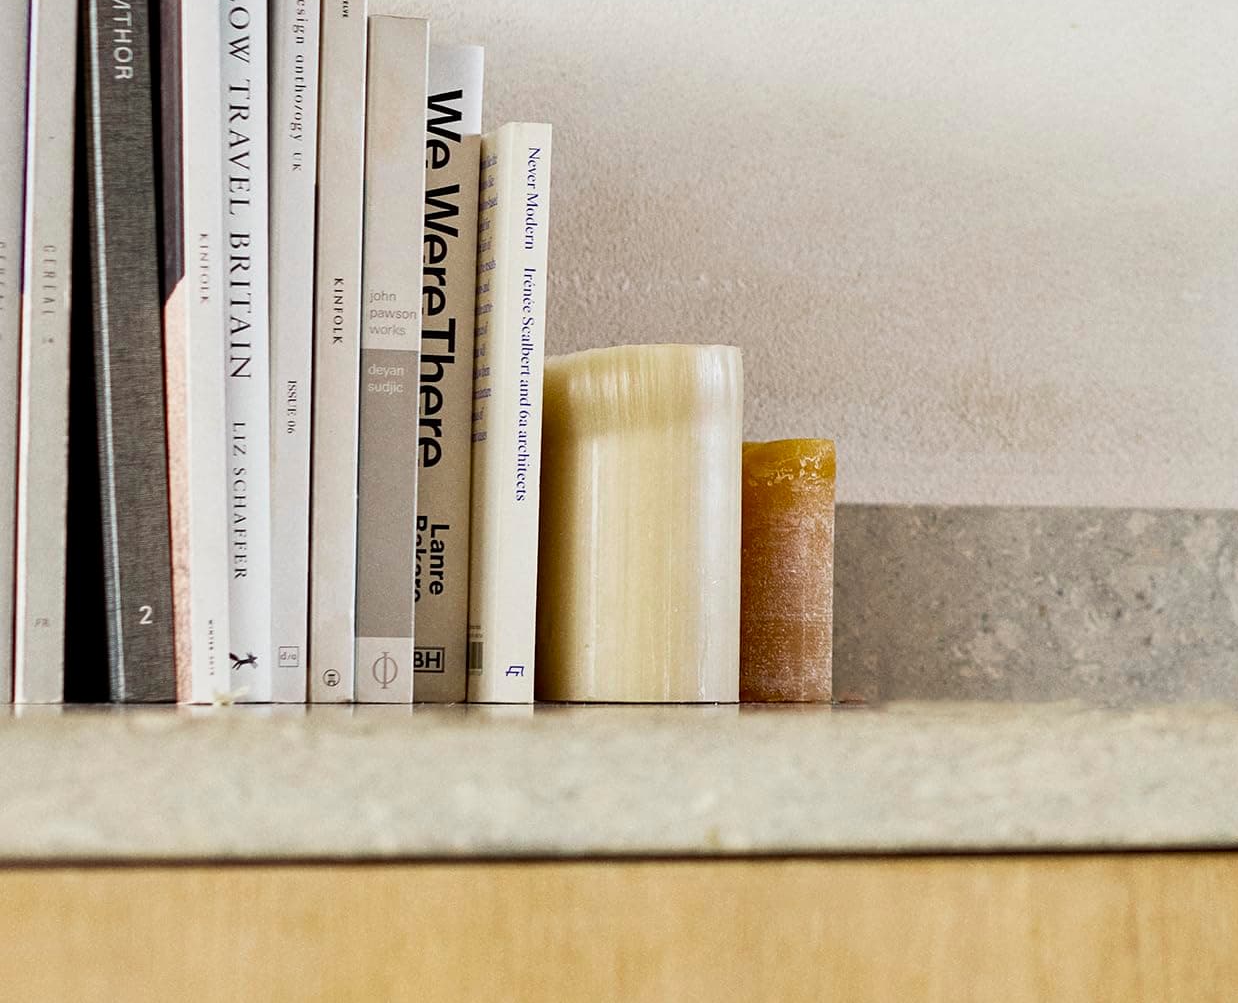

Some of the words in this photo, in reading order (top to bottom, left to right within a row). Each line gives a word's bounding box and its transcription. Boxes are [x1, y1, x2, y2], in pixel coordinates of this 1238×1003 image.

[228, 79, 251, 216] TRAVEL
[426, 90, 464, 169] We
[292, 152, 302, 171] UK
[527, 147, 541, 190] Never
[524, 193, 539, 250] Modern
[199, 233, 209, 303] KINFOLK
[423, 184, 461, 316] Were
[229, 232, 252, 379] BRITAIN
[332, 277, 344, 344] KINFOLK
[369, 290, 397, 303] john
[522, 268, 537, 313] Irénée
[369, 308, 417, 320] pawson
[369, 324, 406, 336] works
[519, 316, 534, 376] Scalbert
[367, 363, 405, 377] deyan
[367, 381, 404, 395] sudjic
[287, 380, 297, 416] ISSUE
[418, 318, 457, 468] There
[518, 379, 532, 407] and
[232, 422, 246, 456] LIZ
[287, 420, 296, 434] 06
[517, 410, 531, 427] 6a
[515, 430, 530, 502] architects
[232, 467, 247, 580] SCHAFFER
[428, 523, 450, 596] Lanre
[138, 605, 153, 625] 2
